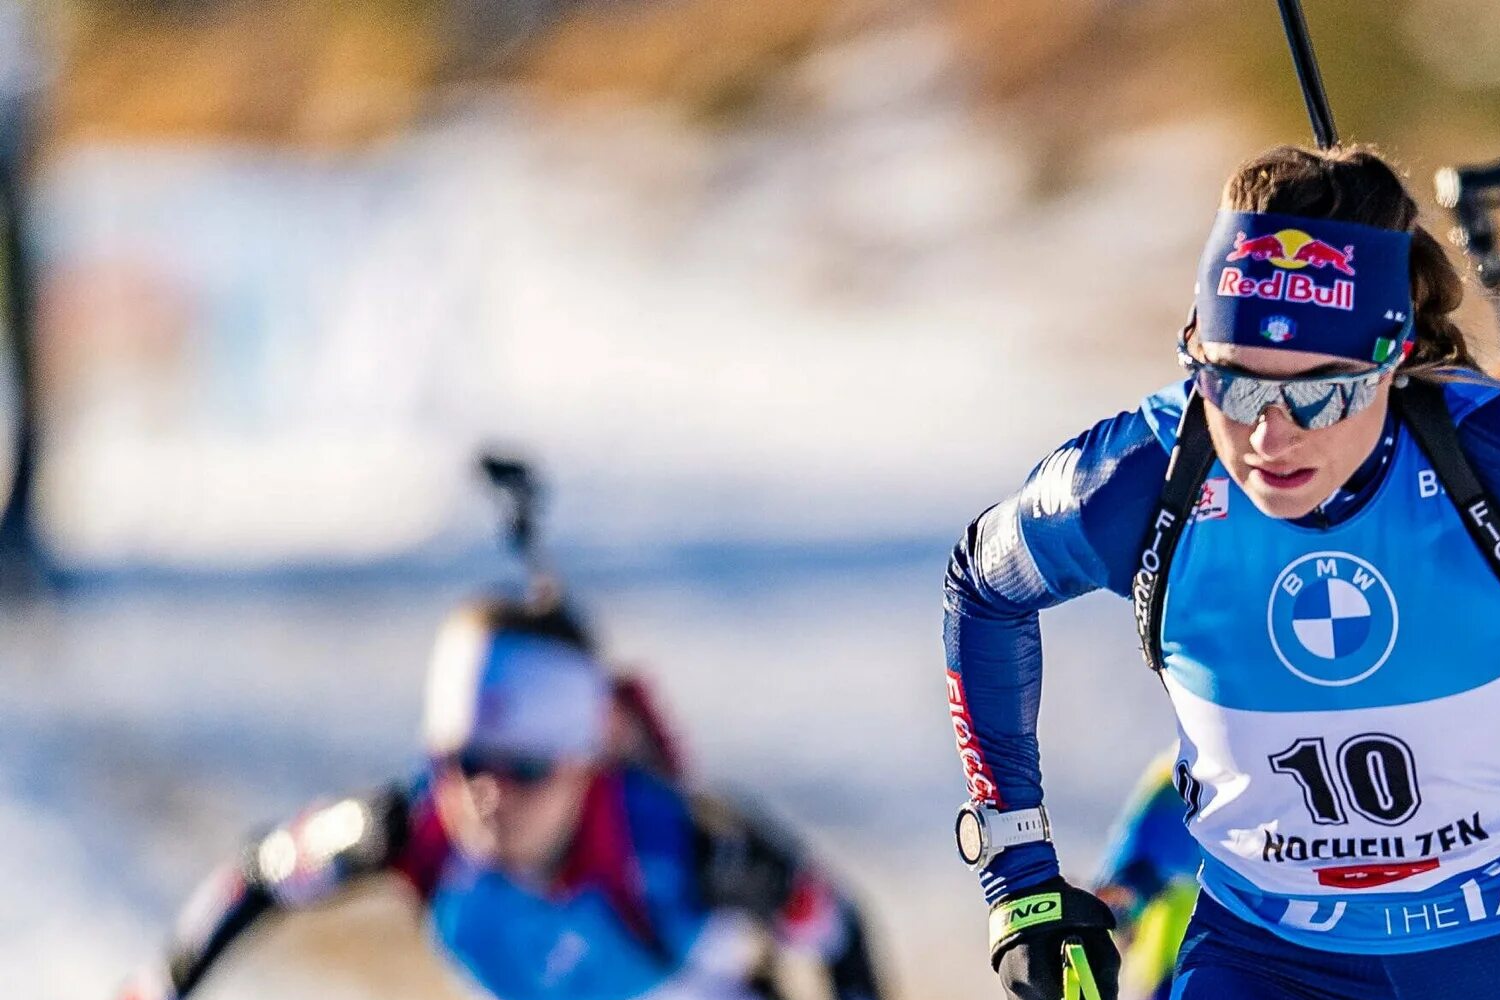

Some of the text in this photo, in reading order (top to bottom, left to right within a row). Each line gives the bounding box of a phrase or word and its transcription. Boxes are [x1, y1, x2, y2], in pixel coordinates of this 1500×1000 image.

[1217, 267, 1355, 311] Red Bull
[1282, 558, 1377, 598] BMW
[1268, 732, 1422, 827] 10
